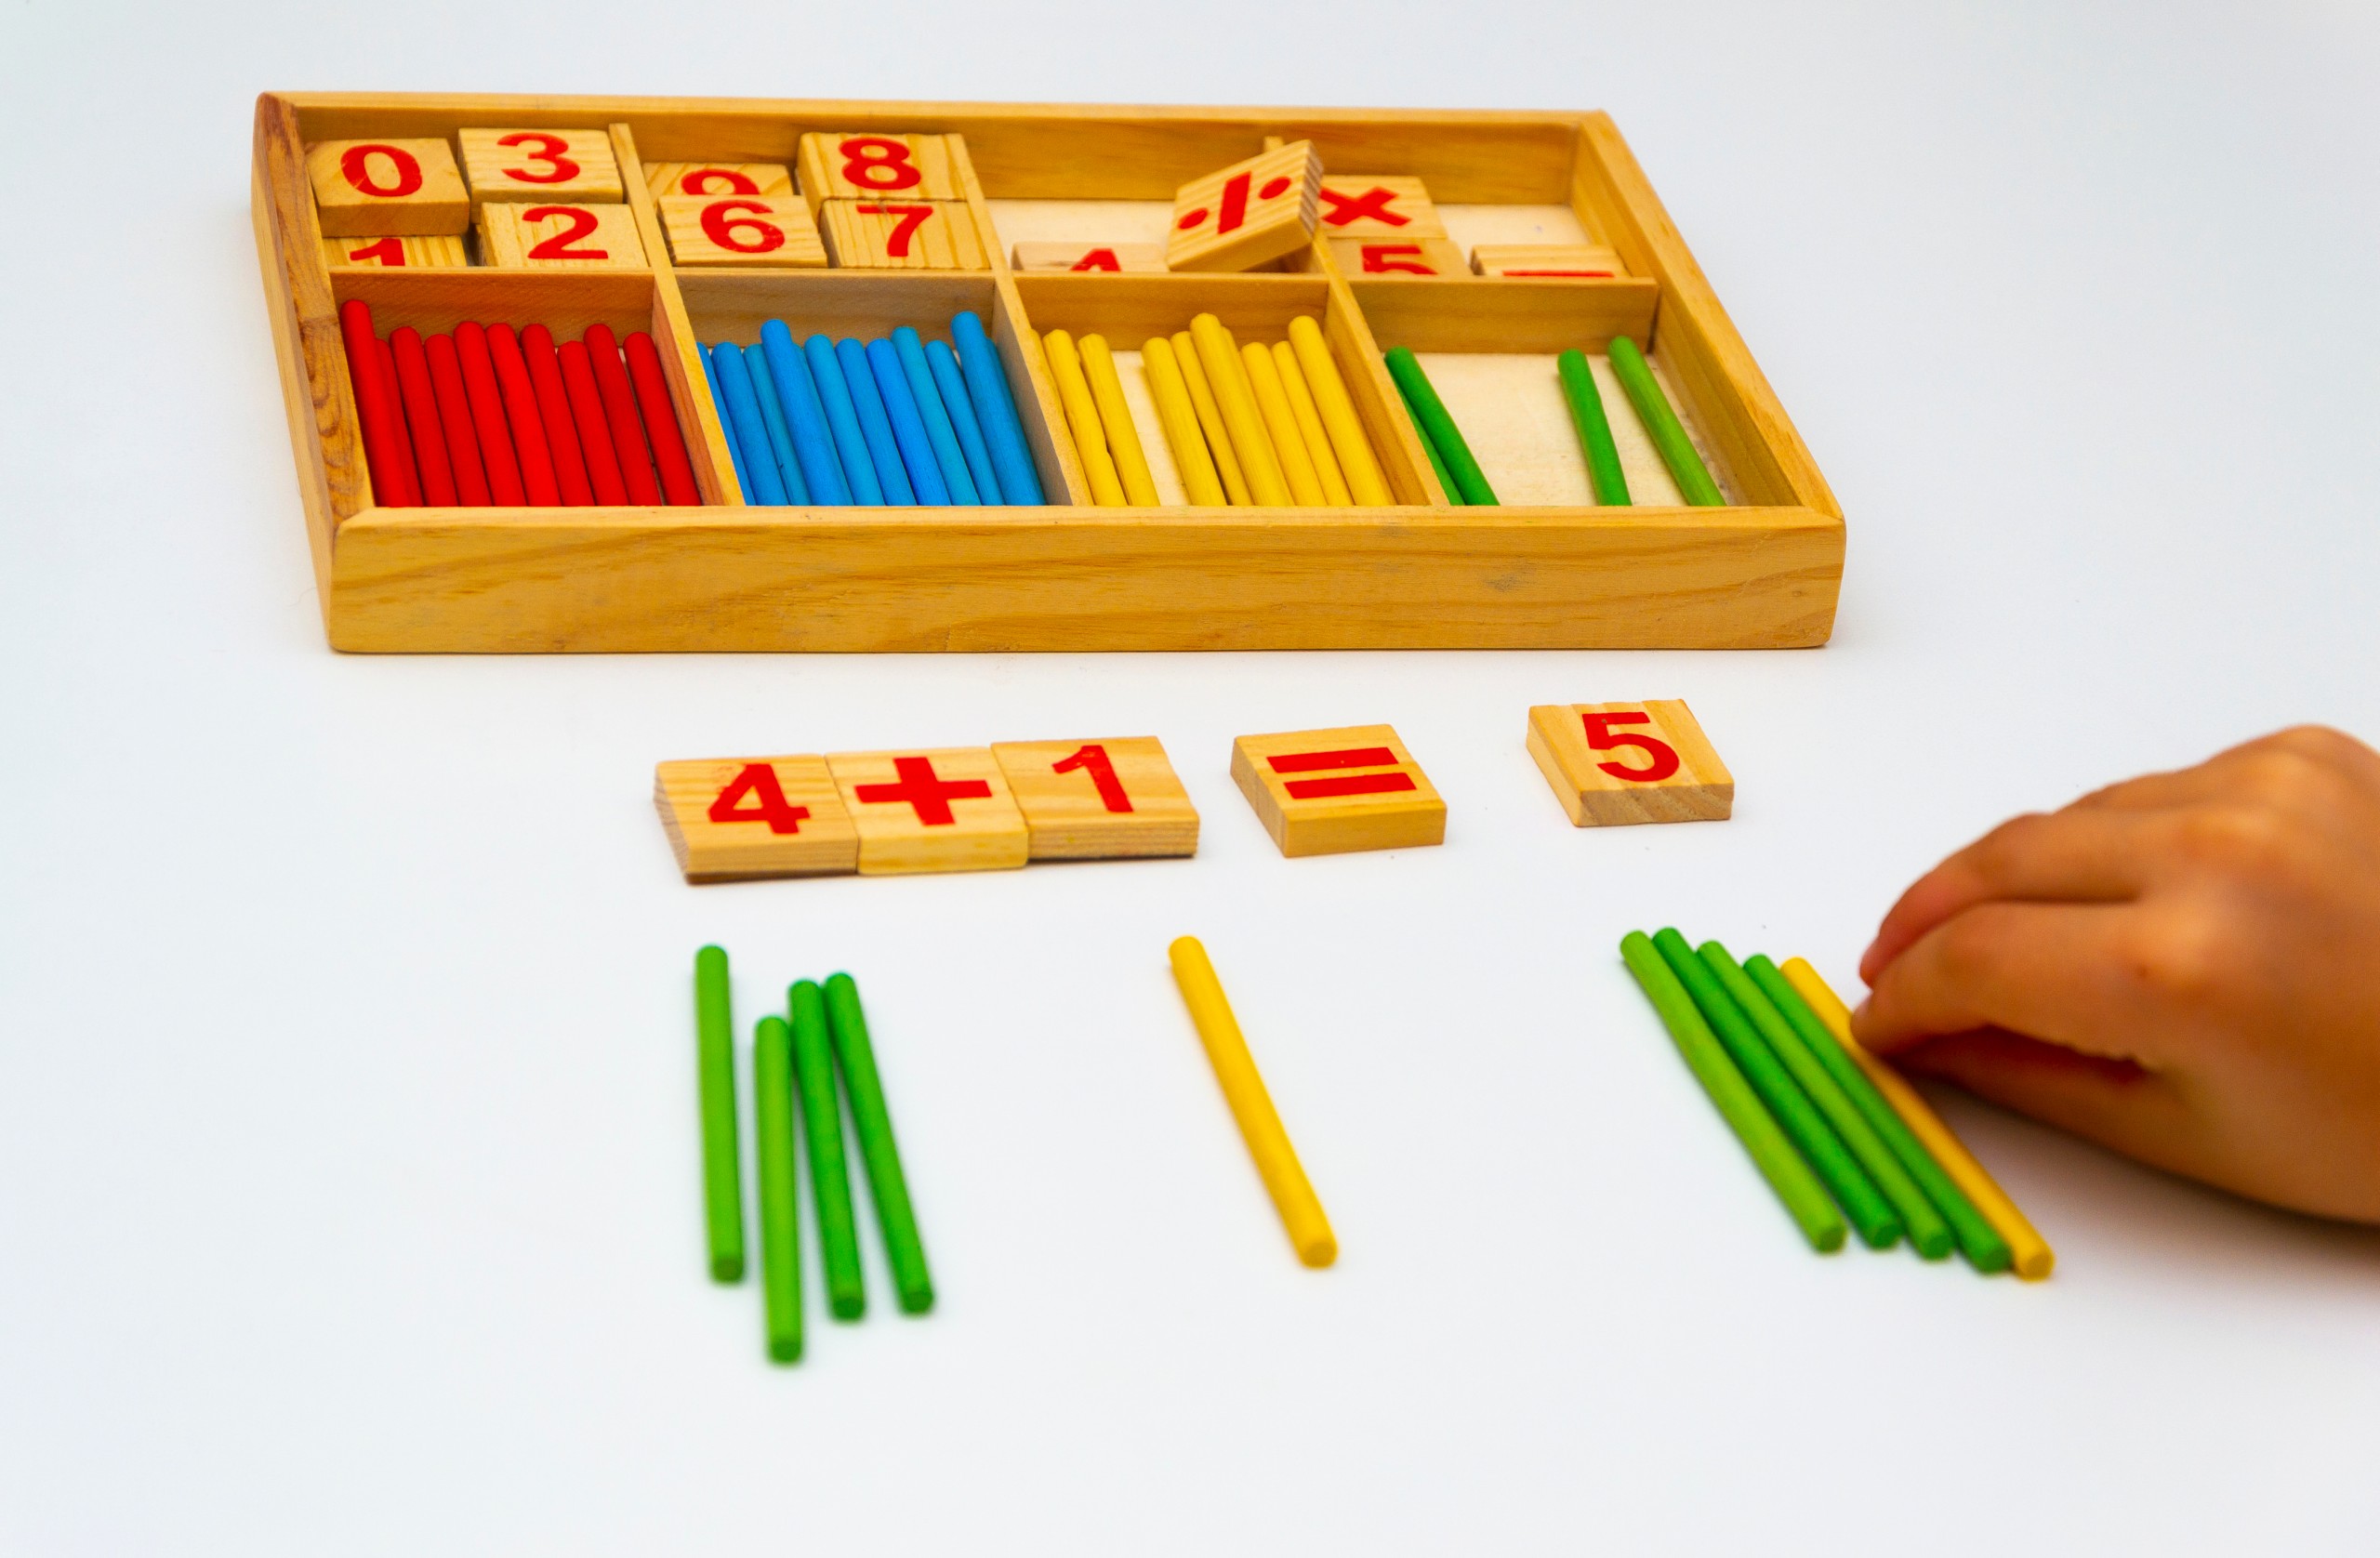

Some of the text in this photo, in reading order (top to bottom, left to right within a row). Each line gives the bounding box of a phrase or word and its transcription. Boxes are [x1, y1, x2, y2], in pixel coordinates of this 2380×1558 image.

[340, 143, 425, 198] 0
[497, 133, 582, 185] 3
[839, 137, 923, 191] 8
[522, 205, 611, 260] 2
[699, 200, 786, 255] 6
[855, 203, 933, 258] 7
[707, 761, 812, 836] 4
[1051, 743, 1134, 814] 1
[1580, 709, 1681, 784] 5
